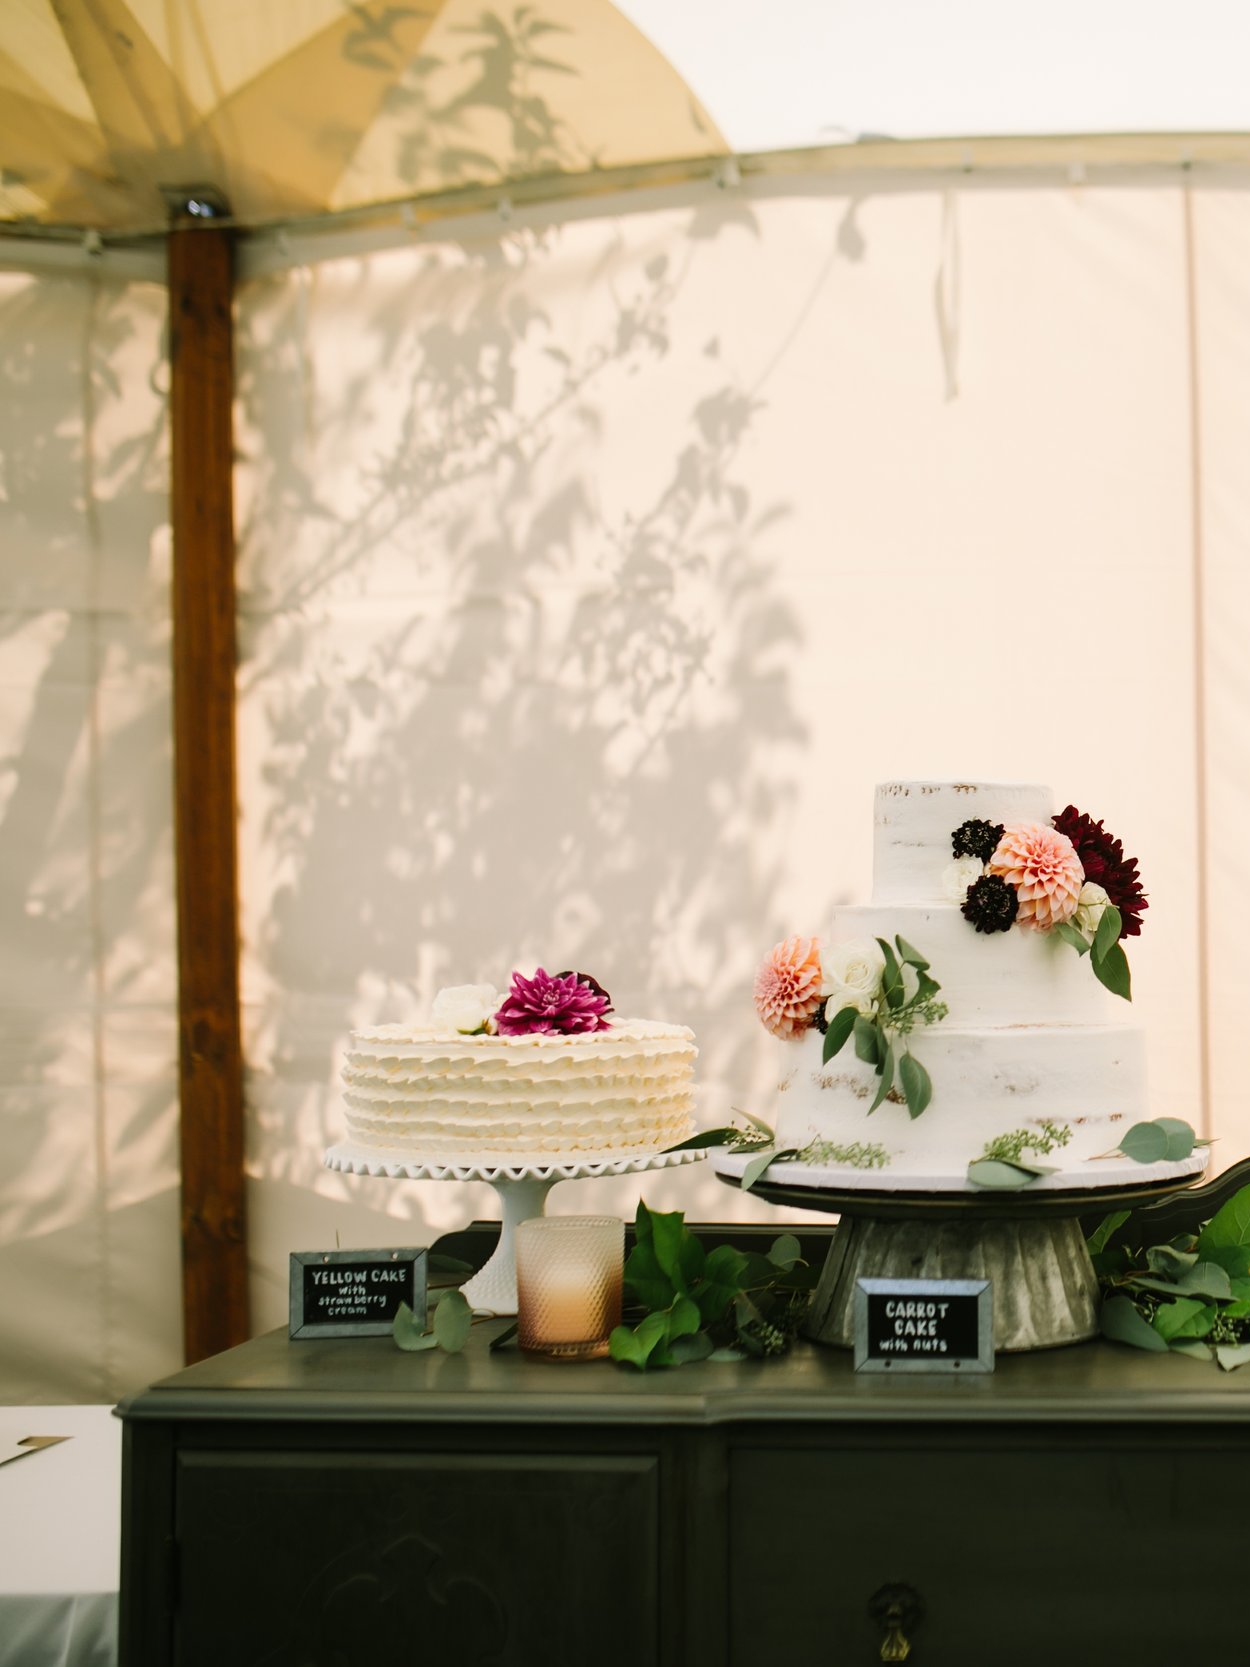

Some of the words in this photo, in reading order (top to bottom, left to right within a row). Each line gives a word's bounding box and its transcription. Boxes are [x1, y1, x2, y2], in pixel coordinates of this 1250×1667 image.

[312, 1270, 367, 1285] YELLOW
[371, 1268, 407, 1282] CAKE
[338, 1285, 366, 1295] with
[318, 1295, 387, 1307] strawberry
[328, 1306, 367, 1316] cream
[885, 1301, 949, 1319] CARROT
[894, 1319, 938, 1336] CAKE
[879, 1337, 908, 1352] with
[913, 1338, 947, 1352] nuts
